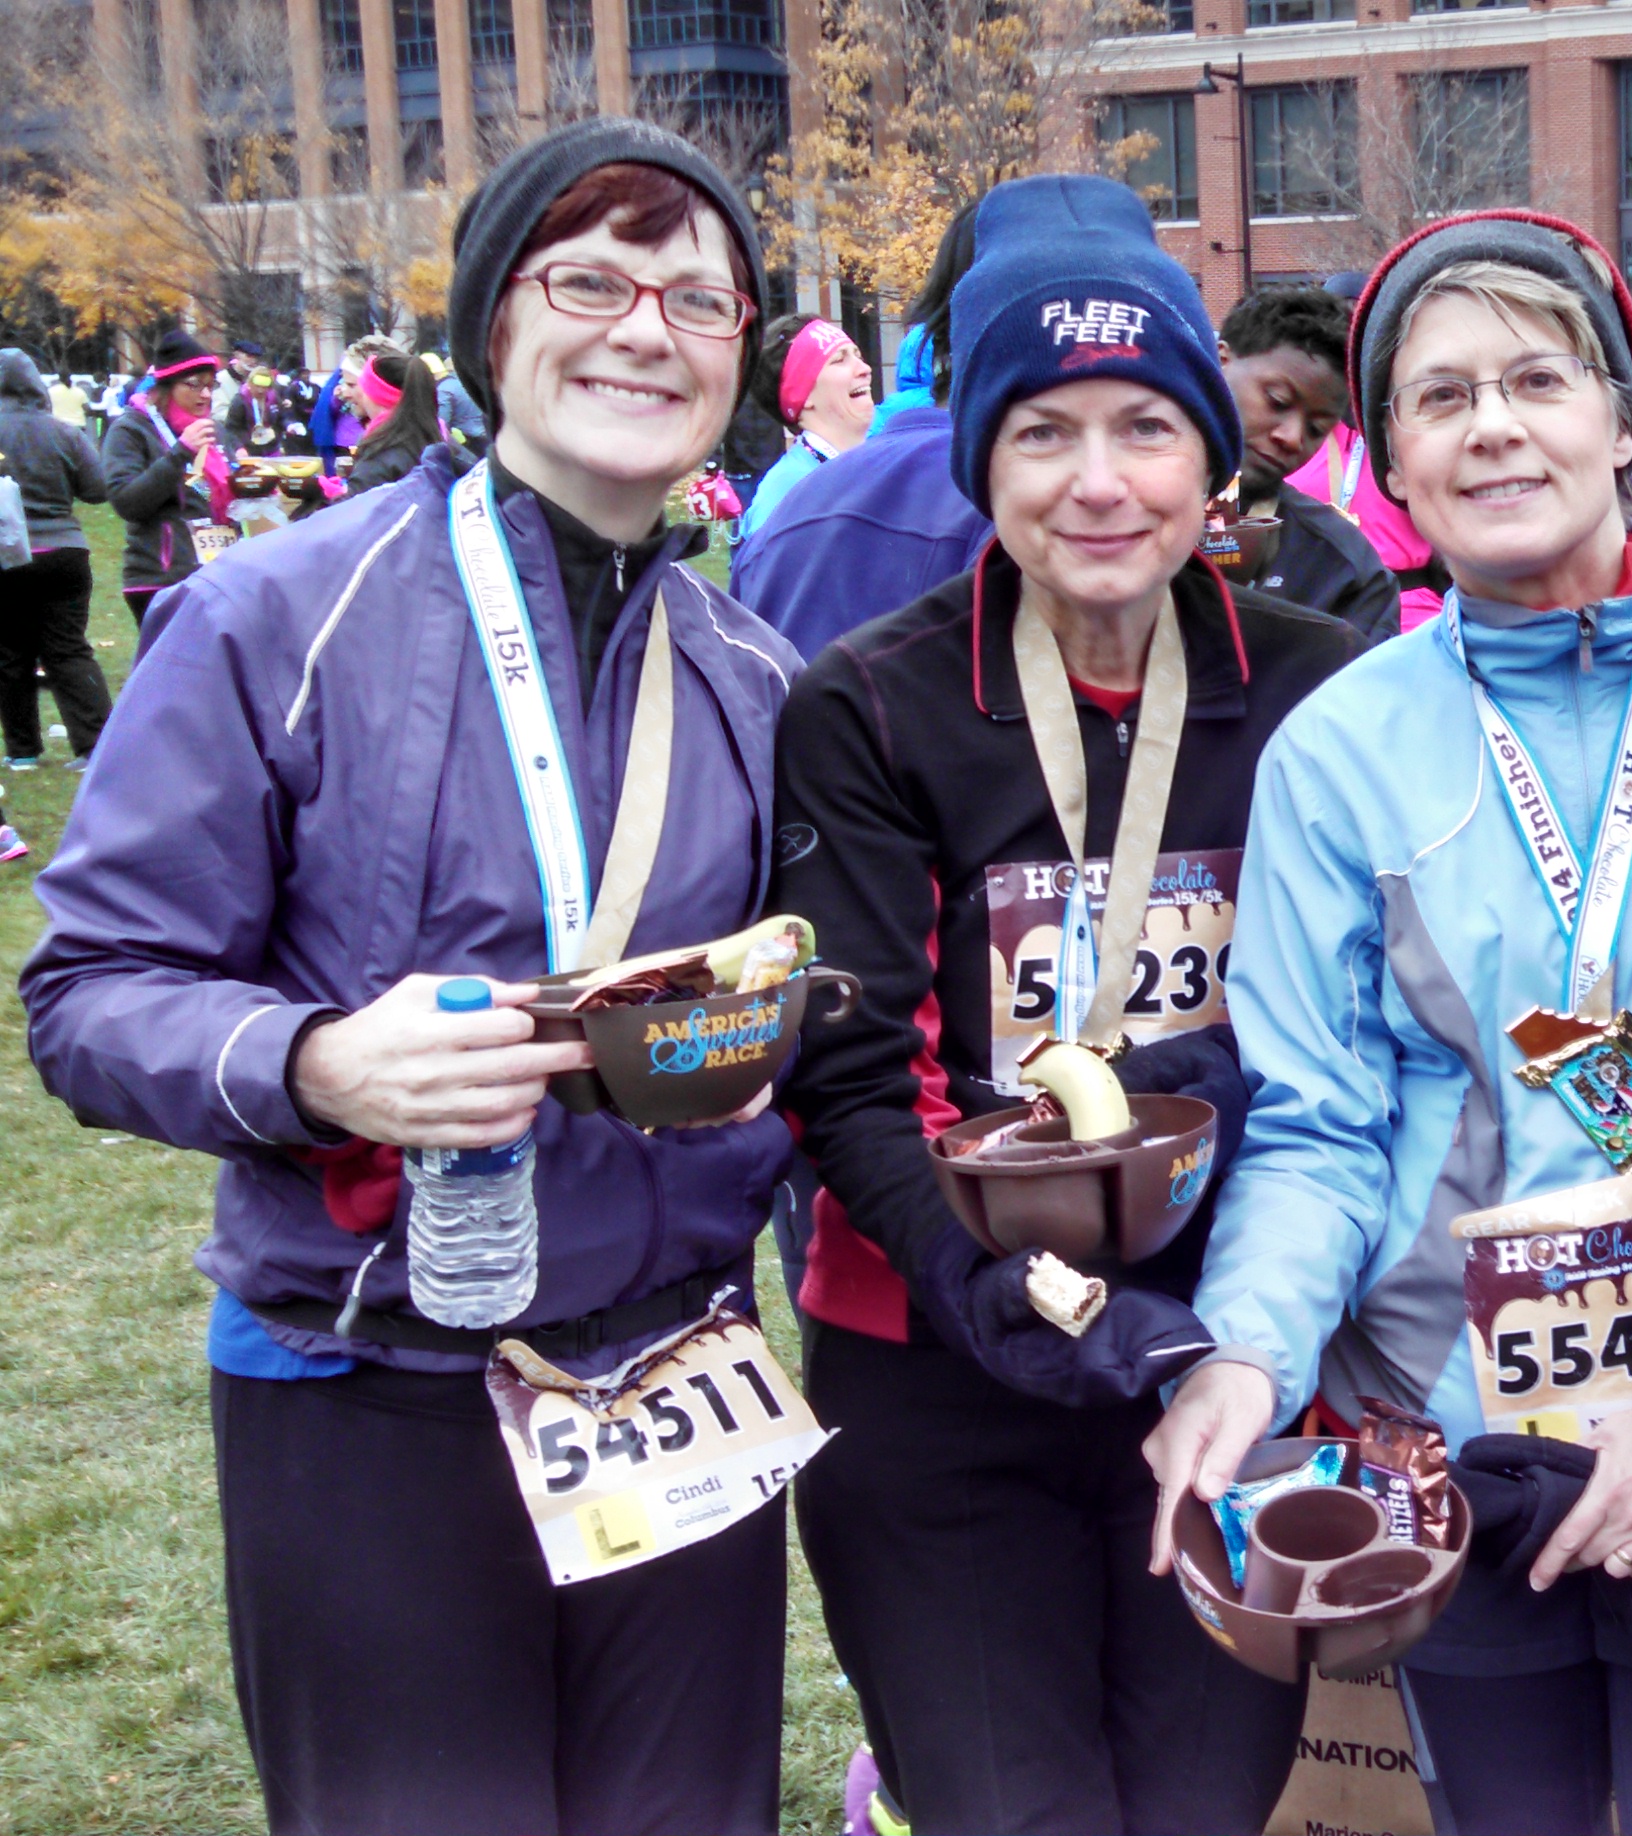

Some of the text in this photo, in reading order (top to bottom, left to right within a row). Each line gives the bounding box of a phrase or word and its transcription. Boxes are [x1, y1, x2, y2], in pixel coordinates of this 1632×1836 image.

[1041, 299, 1151, 328] FLEET
[1054, 321, 1144, 347] FEET
[491, 624, 530, 686] 15k
[1492, 731, 1564, 864] Finisher
[1151, 858, 1218, 892] ocolate
[1592, 824, 1631, 908] Chocolate
[1013, 942, 1232, 1020] 523
[648, 992, 787, 1075] Sweetest
[704, 1042, 765, 1069] RACE
[1462, 1213, 1531, 1238] GEAR
[1493, 1233, 1582, 1274] HOT
[537, 1358, 786, 1494] 54511
[666, 1458, 811, 1505] Cindi 15
[588, 1508, 642, 1561] L
[675, 1504, 732, 1530] Columbus
[1296, 1736, 1421, 1777] NATION
